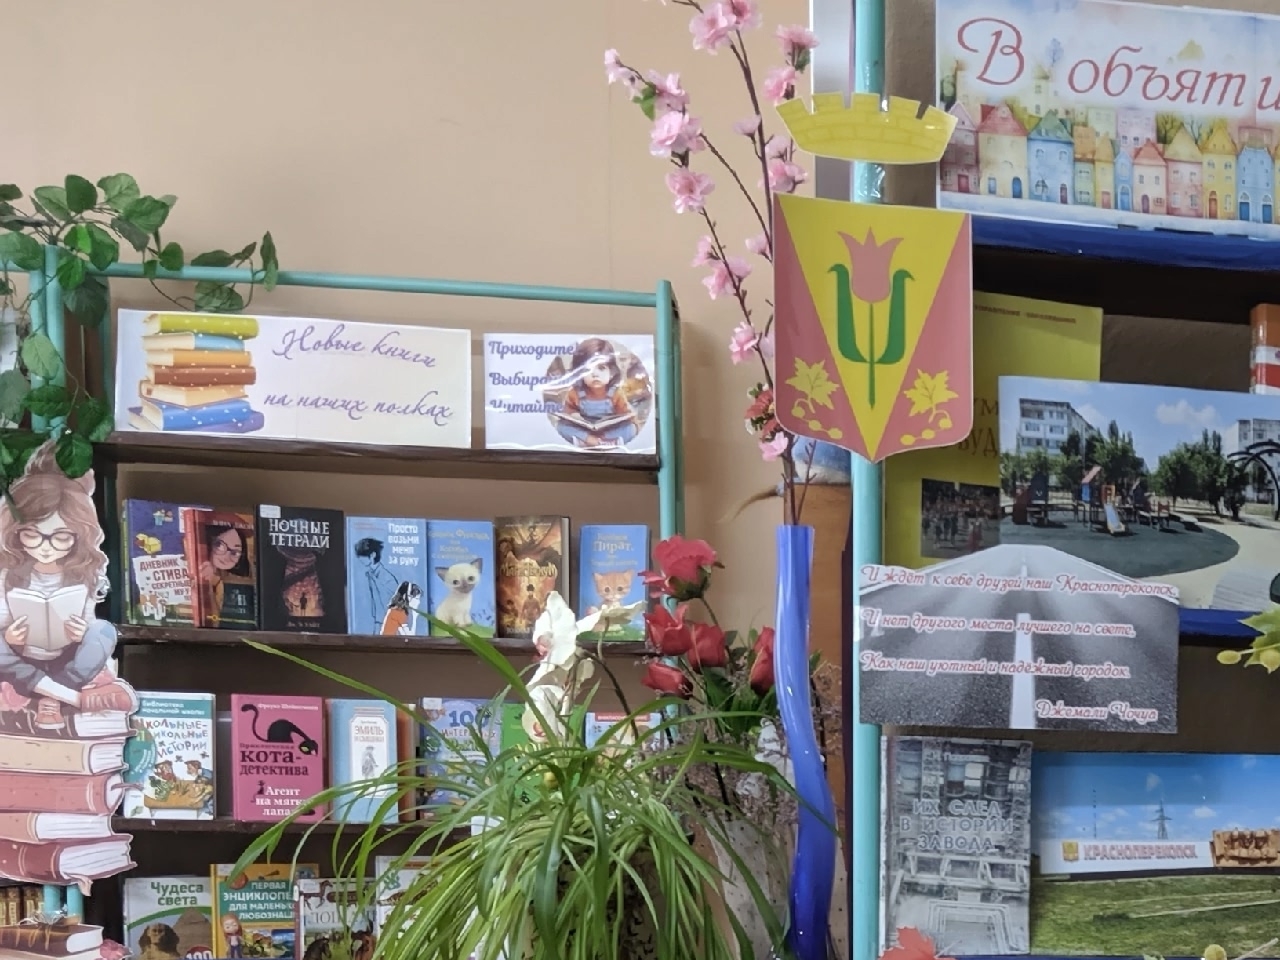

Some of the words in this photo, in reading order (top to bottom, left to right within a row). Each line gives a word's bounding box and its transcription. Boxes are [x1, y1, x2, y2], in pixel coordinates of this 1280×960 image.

[958, 17, 1025, 86] В
[272, 324, 365, 360] Новые
[371, 331, 436, 368] книги
[264, 394, 293, 405] на
[298, 396, 368, 421] наших
[374, 390, 454, 427] полках
[269, 519, 330, 535] НОЧНЫЕ
[269, 533, 330, 549] ТЕТРАДИ
[139, 559, 179, 571] ДНЕВНИК
[153, 569, 189, 581] СТИВА
[932, 573, 941, 585] к
[944, 573, 973, 587] себе
[976, 573, 1023, 593] друзей
[1026, 578, 1052, 591] наш
[882, 616, 908, 628] нет
[912, 616, 966, 633] другого
[969, 618, 1013, 631] места
[1017, 620, 1072, 637] лучшего
[1075, 623, 1091, 634] на
[861, 653, 894, 671] Как
[898, 659, 924, 672] наш
[927, 659, 985, 676] уютный
[988, 661, 997, 673] и
[240, 765, 309, 776] детектива
[265, 787, 301, 796] Агент
[256, 797, 271, 806] на
[274, 798, 309, 807] мягк
[262, 808, 295, 817] лапа
[151, 881, 203, 896] Чудеса
[251, 881, 286, 890] ПЕРВАЯ
[157, 896, 198, 906] света
[223, 891, 295, 902] ЭНЦИКЛОПЕ
